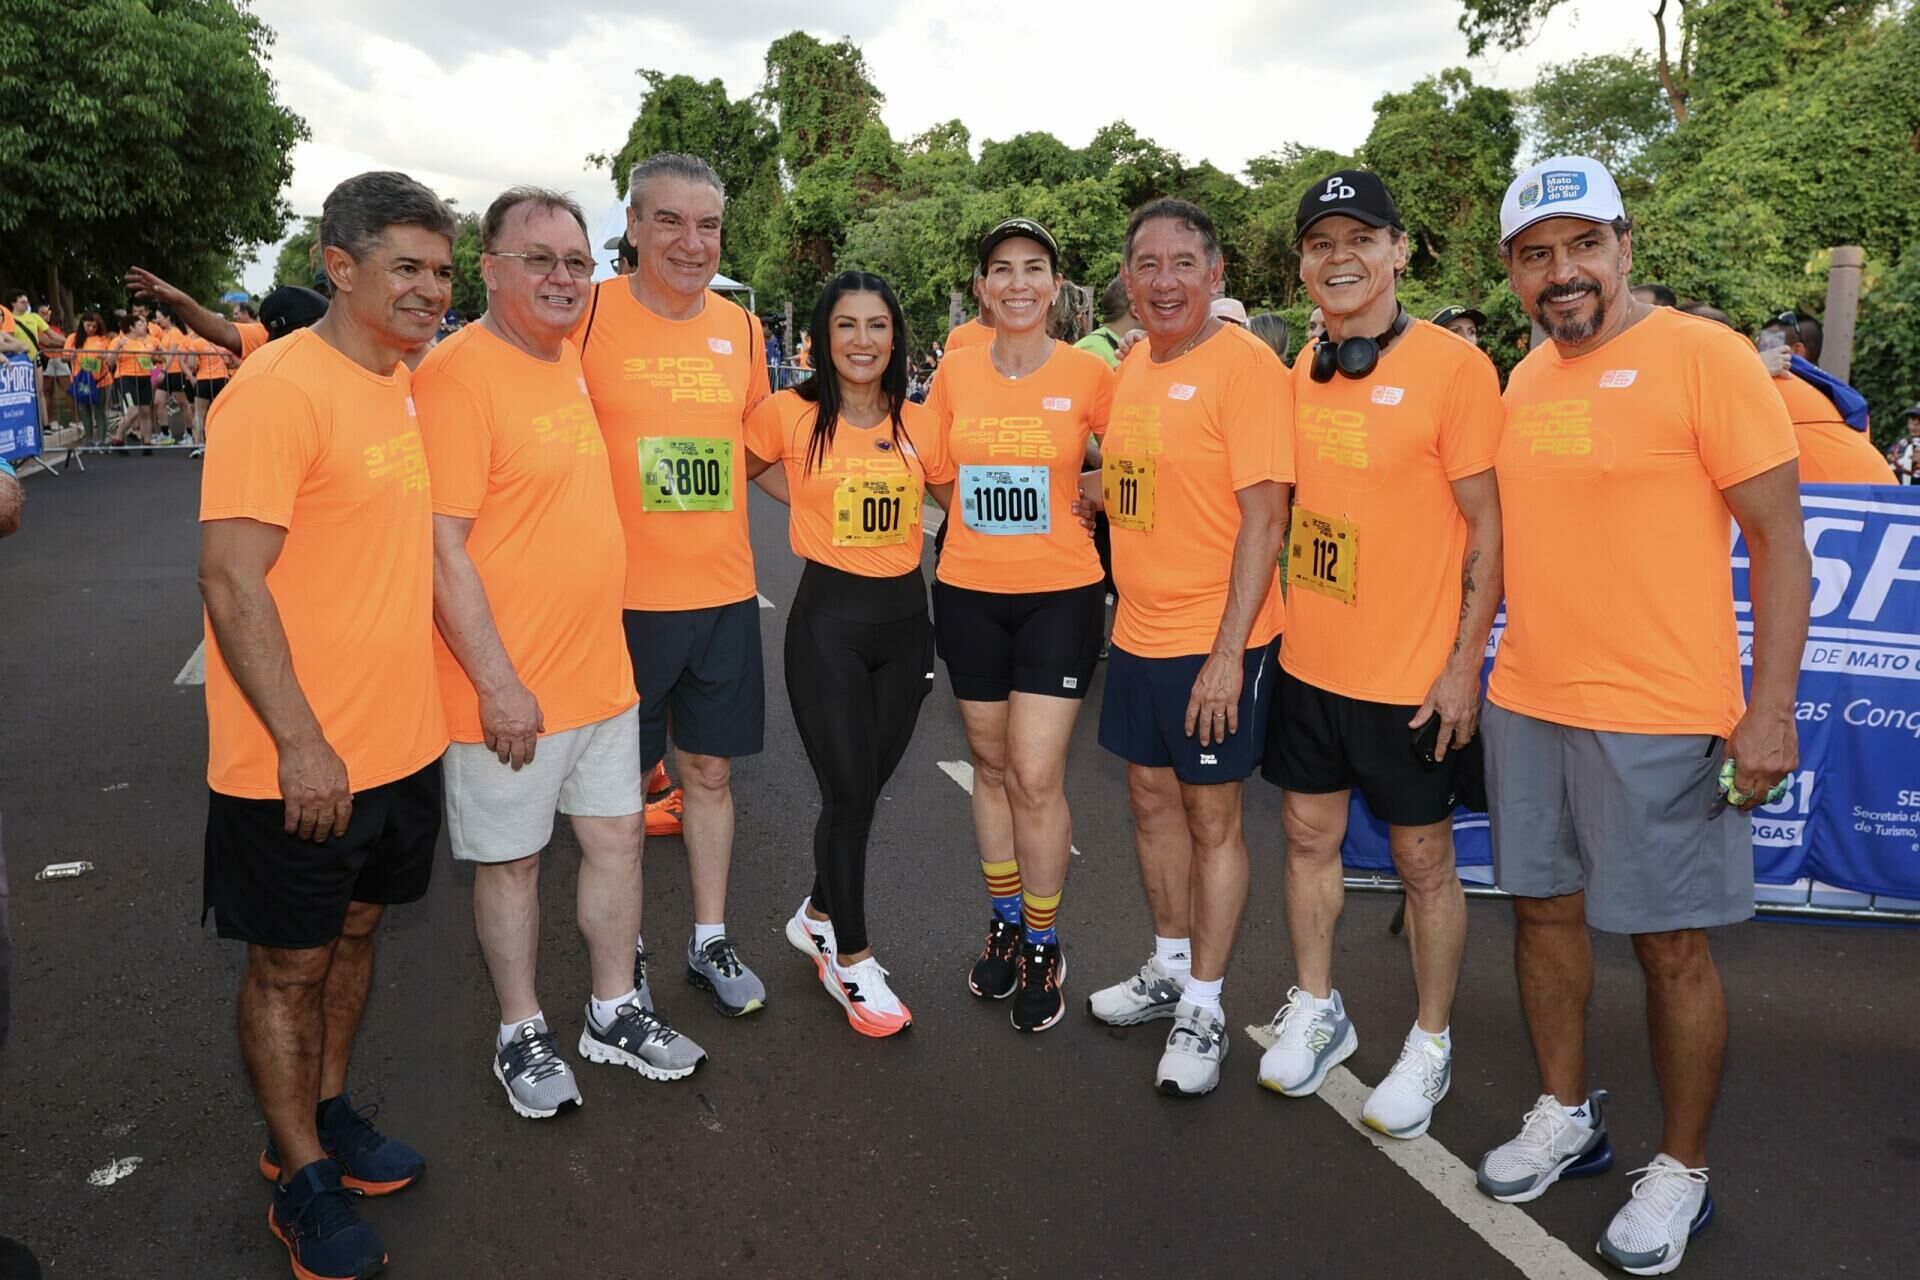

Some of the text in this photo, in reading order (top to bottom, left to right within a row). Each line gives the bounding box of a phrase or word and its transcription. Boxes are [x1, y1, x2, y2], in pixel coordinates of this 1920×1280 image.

[1547, 177, 1571, 186] Mato
[1548, 185, 1580, 193] Grosso
[658, 357, 714, 371] PO
[678, 372, 725, 387] DE
[672, 388, 734, 403] RES
[980, 416, 1042, 430] PO
[1317, 407, 1365, 429] PO
[998, 430, 1052, 444] DE
[1327, 427, 1368, 449] DE
[988, 444, 1057, 459] RES
[846, 458, 903, 472] PO
[659, 458, 720, 496] 3800
[973, 487, 1038, 522] 11000
[1119, 477, 1137, 516] 111
[862, 497, 901, 532] 001
[1312, 537, 1338, 583] 112
[1811, 647, 1910, 670] DE MATO
[1852, 806, 1908, 823] Secretaria
[1854, 821, 1918, 839] de Turismo,
